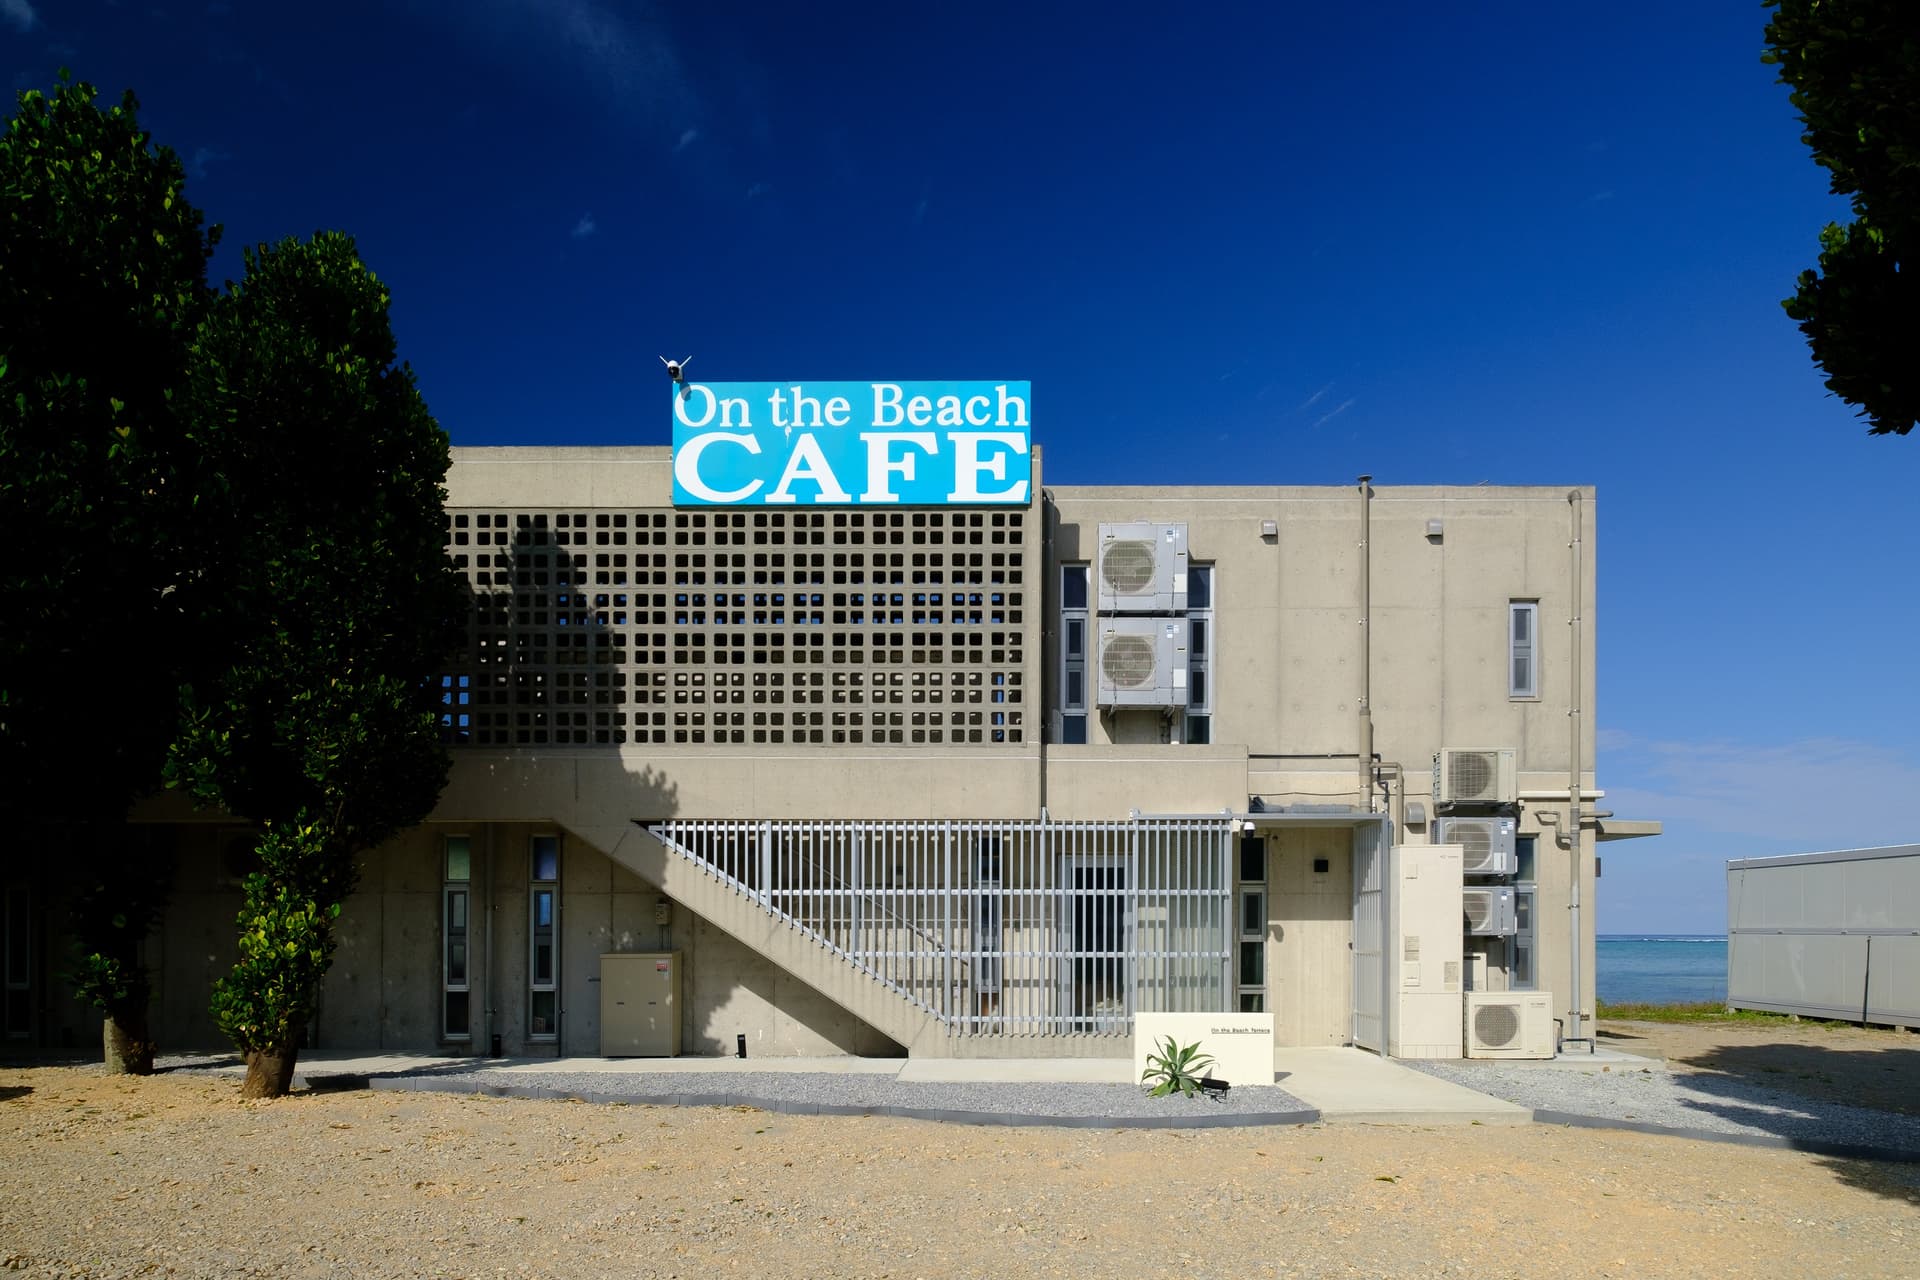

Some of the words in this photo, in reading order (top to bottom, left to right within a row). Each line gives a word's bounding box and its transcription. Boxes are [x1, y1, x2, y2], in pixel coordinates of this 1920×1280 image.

[674, 384, 752, 428] On
[768, 385, 850, 428] the
[871, 384, 1029, 427] Beach
[674, 431, 1028, 503] CAFE
